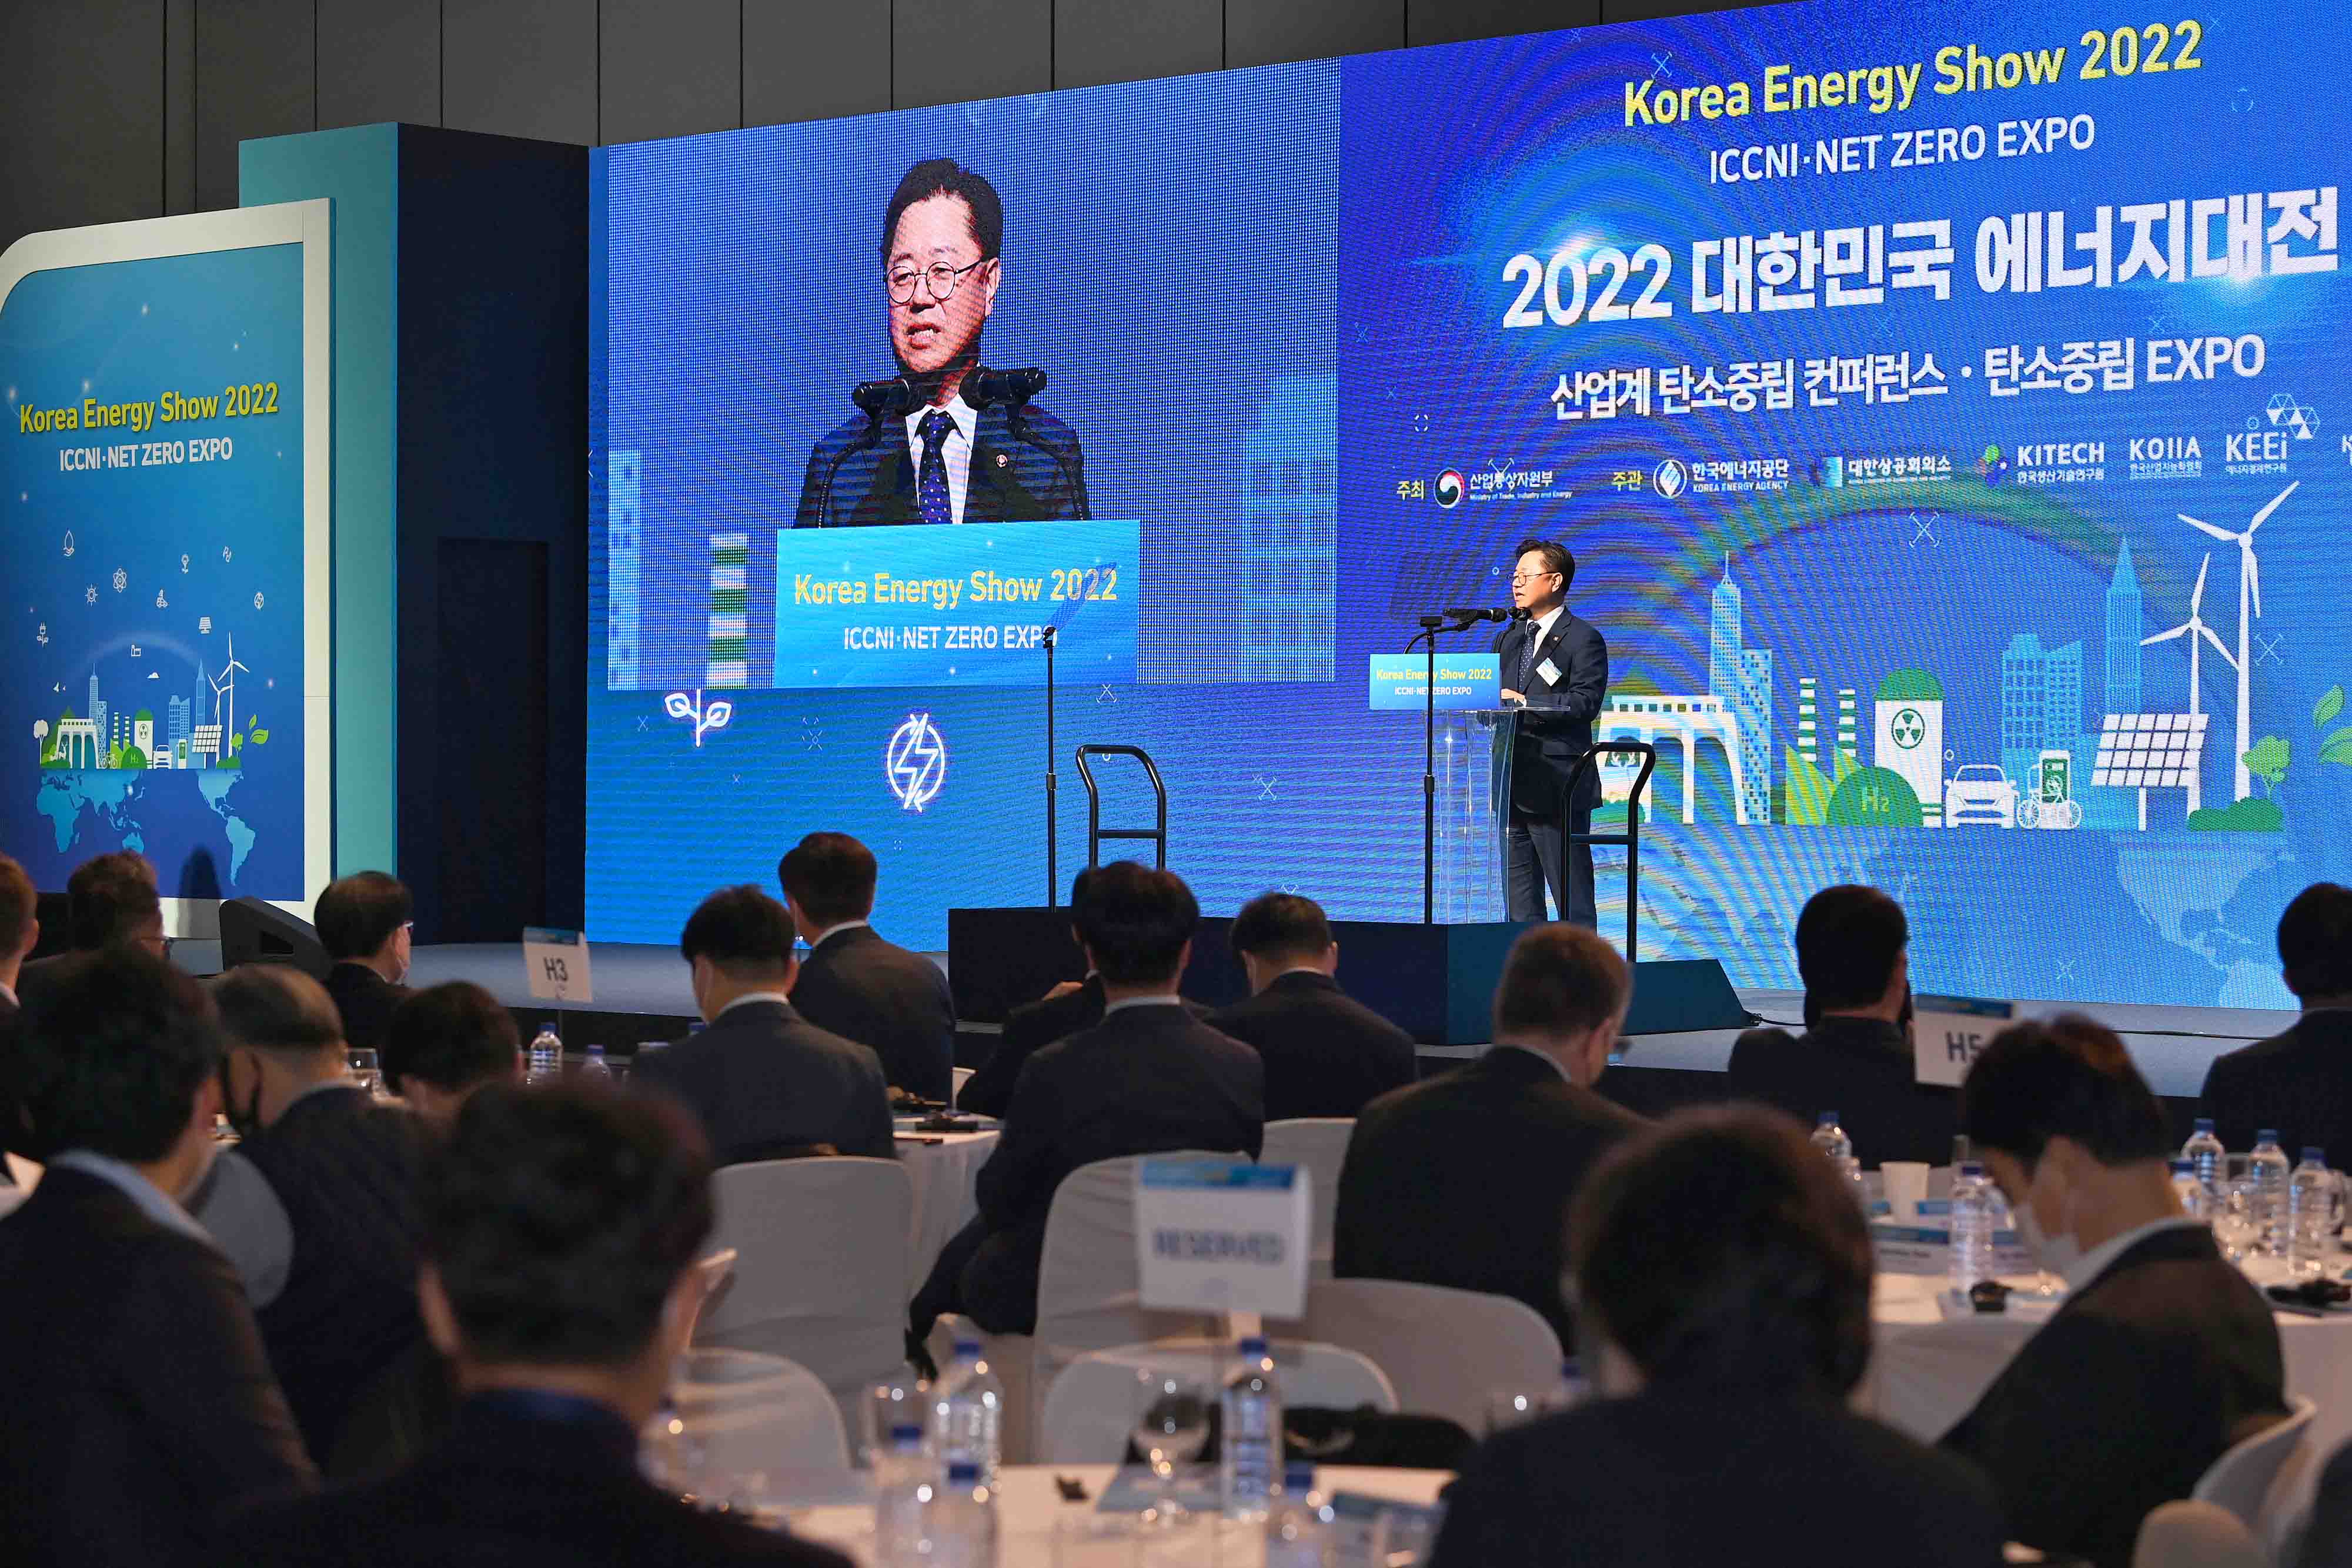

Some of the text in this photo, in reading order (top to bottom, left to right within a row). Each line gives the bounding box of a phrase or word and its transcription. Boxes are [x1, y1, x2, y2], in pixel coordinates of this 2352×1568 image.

[1625, 19, 2202, 127] Korea Energy Show 2022
[1890, 125, 1986, 168] ZERO
[1997, 114, 2094, 158] EXPO
[1502, 186, 2339, 328] 2022 대한민국 에너지대전
[1550, 367, 1652, 421] 산업계
[1658, 359, 1795, 414] 탄소중립
[1803, 351, 1949, 407] 컨퍼런스
[1984, 337, 2136, 396] 탄소중립
[2146, 333, 2266, 383] EXPO
[19, 382, 279, 433] Korea Energy Show 2022
[141, 441, 185, 466] ZERO
[188, 437, 233, 462] EXPO
[2017, 442, 2104, 466] KITECH
[2130, 436, 2202, 461] KOIIA
[1692, 459, 1789, 482] 한국에너지공단
[1848, 455, 1952, 477] 대한상공회의소
[1396, 480, 1424, 499] 주최
[1469, 471, 1553, 490] 산업통상자원부
[1613, 470, 1643, 491] 주관
[1693, 480, 1789, 493] KOREA ENERGY AGENCY
[794, 568, 1118, 610] Korea Energy Show 2022
[944, 625, 998, 649] ZERO
[1377, 668, 1492, 683] Korea Enery Show 2022
[1432, 687, 1451, 695] ZERO
[1452, 687, 1472, 695] EXPO
[543, 957, 569, 981] H3
